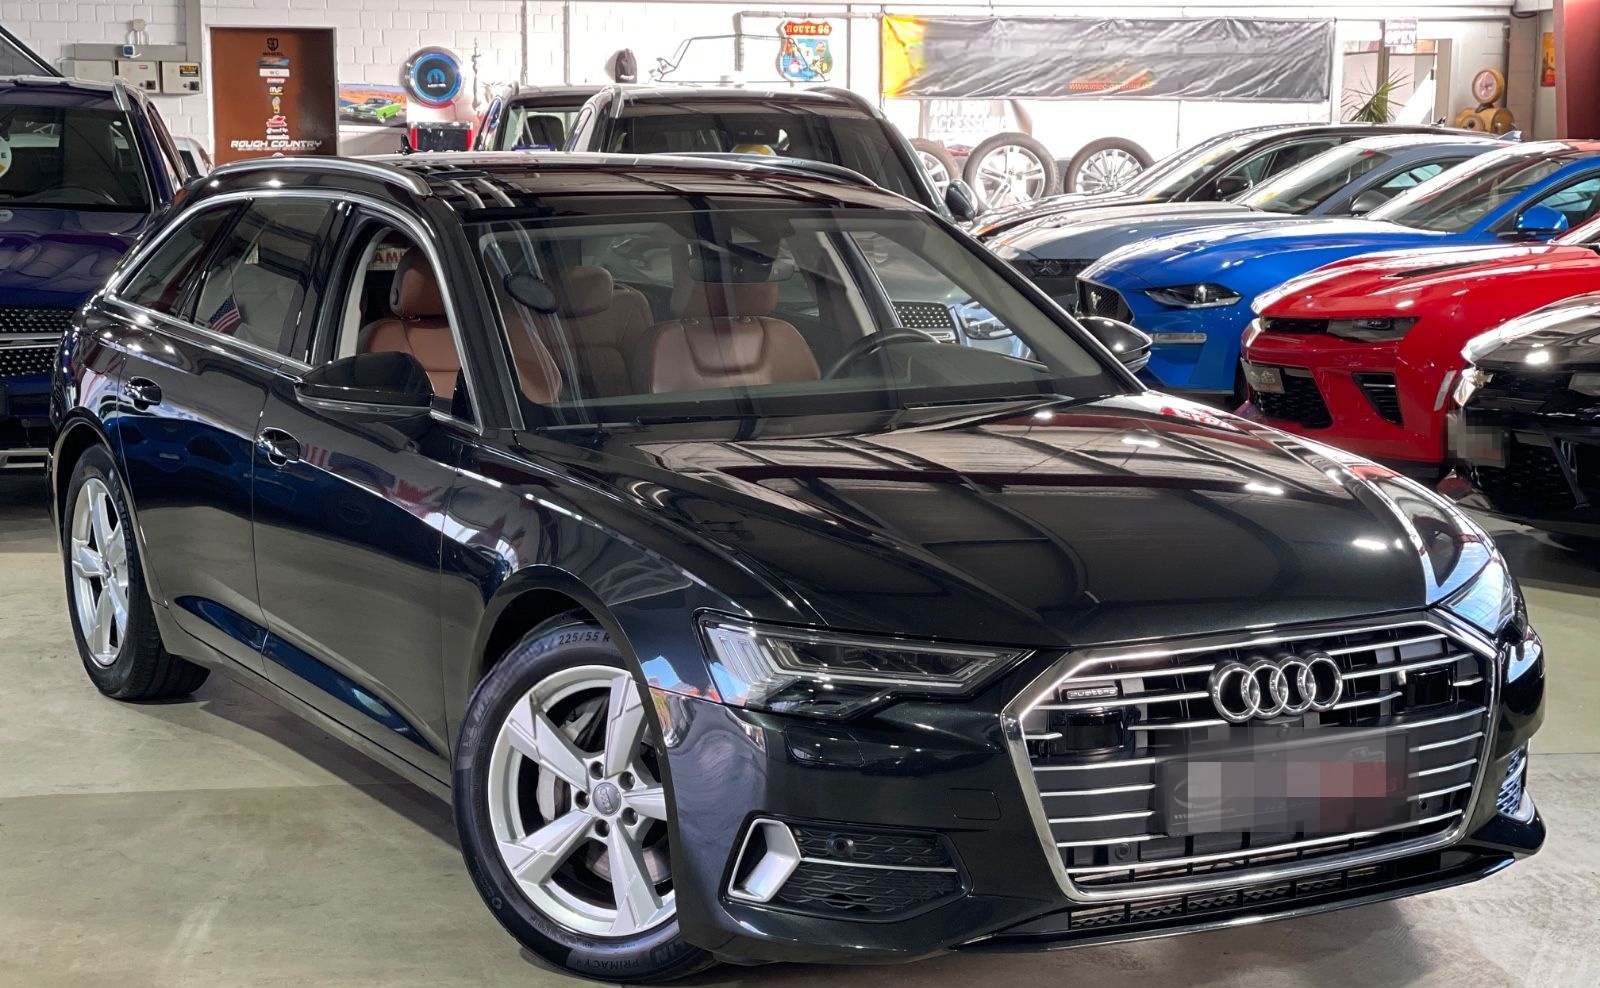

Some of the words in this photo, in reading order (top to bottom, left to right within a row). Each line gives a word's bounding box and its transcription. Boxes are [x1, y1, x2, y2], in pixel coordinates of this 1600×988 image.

[786, 25, 816, 33] ROUTE
[817, 25, 830, 34] 66
[230, 140, 269, 149] ROUGH
[270, 140, 322, 149] COUNTRY
[559, 631, 601, 645] 225/55
[1069, 688, 1116, 698] quattro
[583, 957, 640, 970] PRIMACY
